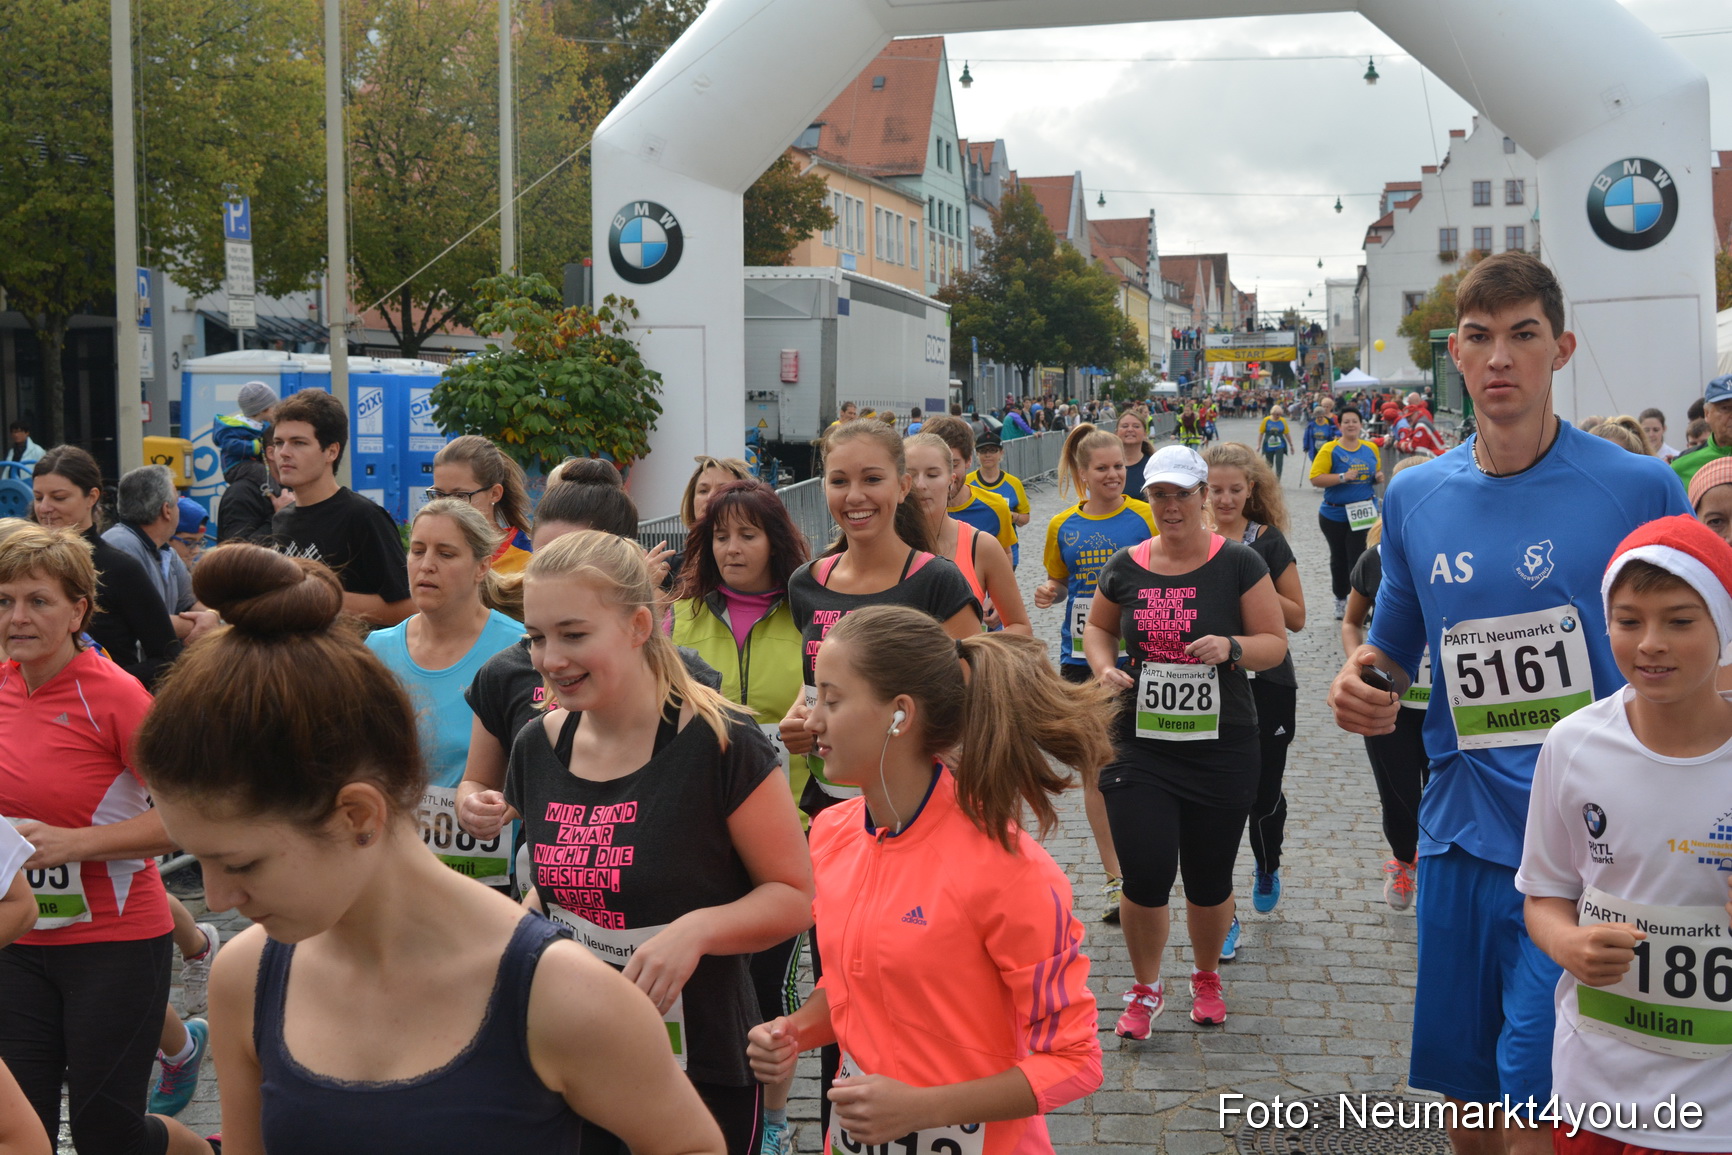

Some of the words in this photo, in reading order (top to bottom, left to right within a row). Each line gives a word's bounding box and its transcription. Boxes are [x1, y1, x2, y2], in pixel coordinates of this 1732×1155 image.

[1593, 160, 1672, 192] BMW
[229, 193, 244, 232] P
[612, 202, 677, 230] BMW
[172, 352, 179, 370] 3
[1234, 350, 1266, 359] START
[358, 392, 383, 416] DIXI
[410, 398, 438, 416] DI
[1430, 551, 1474, 584] AS
[1138, 588, 1161, 599] WIR
[1165, 587, 1196, 598] SIND
[1147, 599, 1183, 608] ZWAR
[813, 611, 840, 624] WIR
[1134, 609, 1170, 620] NICHT
[1175, 609, 1197, 620] DIE
[1138, 620, 1190, 632] BESTEN,
[1148, 631, 1180, 641] ABER
[1444, 632, 1484, 646] PARTL
[1487, 623, 1555, 643] Neumarkt
[1142, 668, 1164, 678] PARTL
[1166, 671, 1205, 679] Neumarkt
[1457, 640, 1572, 699] 5161
[1145, 681, 1213, 711] 5028
[1409, 690, 1431, 700] Frizz
[1453, 696, 1460, 705] S
[1158, 717, 1195, 730] Verena
[1487, 707, 1561, 729] Andreas
[546, 803, 585, 825] WIR
[590, 802, 637, 824] SIND
[557, 824, 614, 845] ZWAR
[534, 844, 590, 865] NICHT
[595, 846, 634, 867] DIE
[1667, 838, 1695, 854] 14.
[538, 866, 620, 892] BESTEN,
[554, 889, 605, 909] ABER
[562, 905, 626, 930] SERE
[901, 916, 927, 926] adidas
[1636, 918, 1721, 938] Neumarkt
[584, 933, 638, 957] Neumark
[1632, 941, 1732, 1003] 186
[1624, 1006, 1693, 1037] Julian
